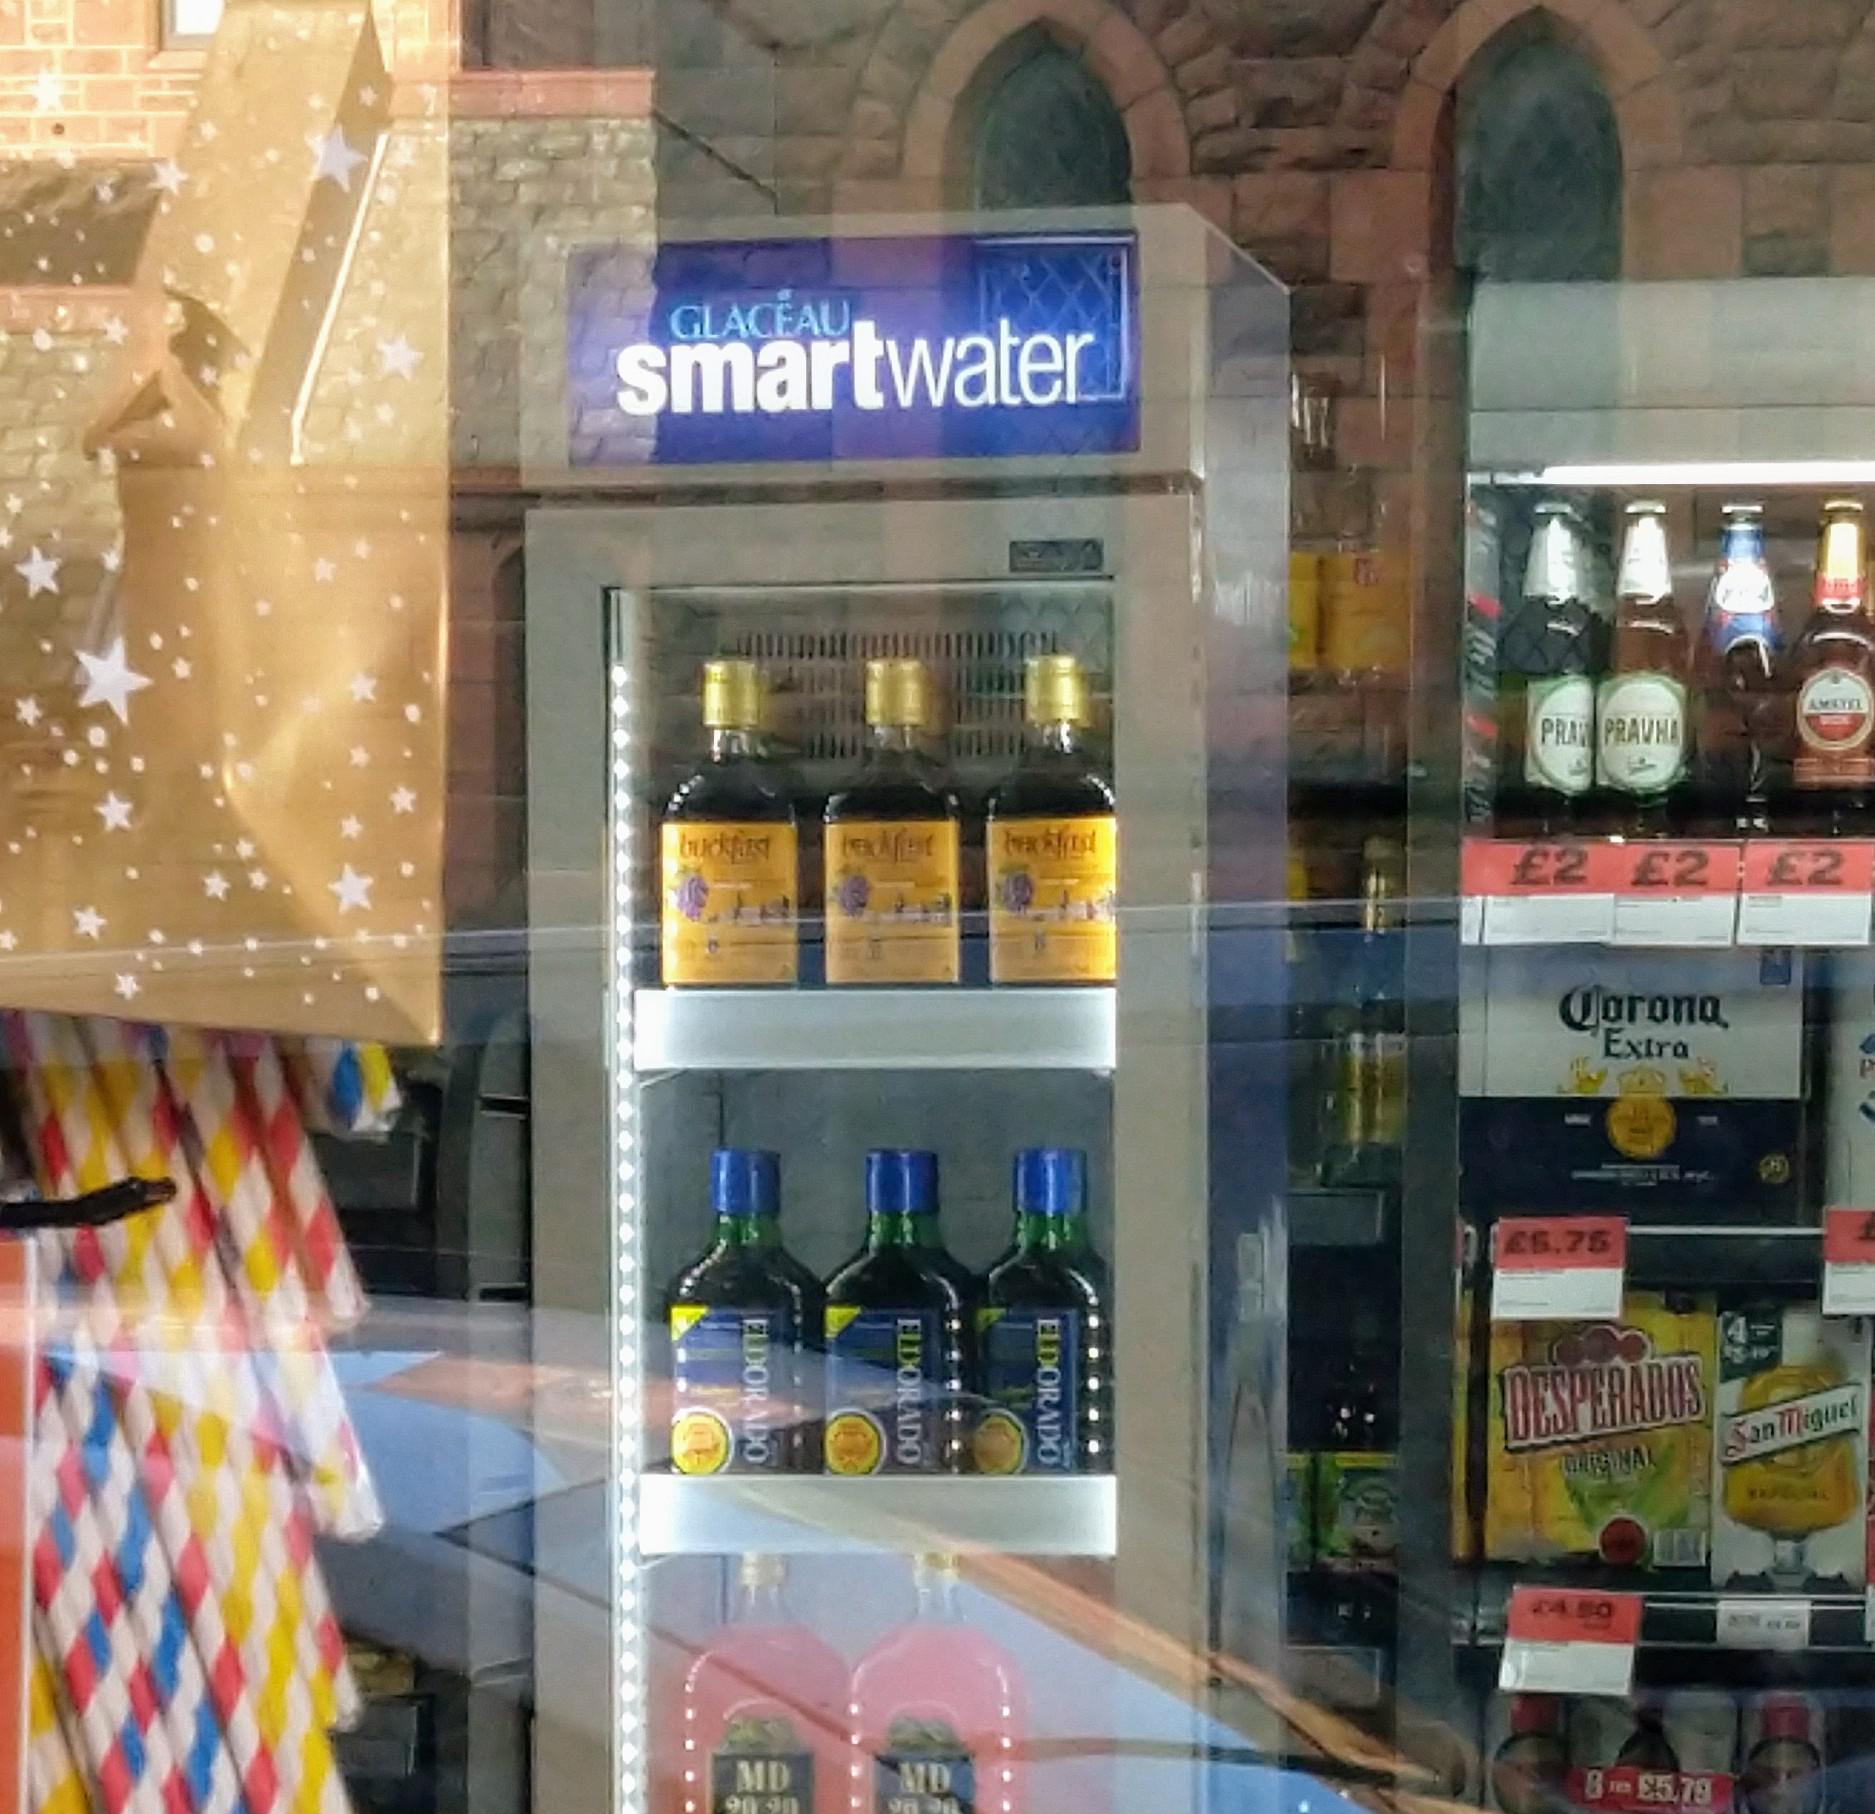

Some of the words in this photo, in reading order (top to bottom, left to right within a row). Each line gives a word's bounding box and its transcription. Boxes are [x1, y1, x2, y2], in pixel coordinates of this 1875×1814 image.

[614, 317, 1095, 417] smartwater
[1604, 717, 1679, 745] PRAVHA
[1510, 847, 1589, 886] £2
[1631, 849, 1709, 887] £2
[1767, 849, 1844, 886] £2
[1559, 984, 1729, 1037] Corona
[1603, 1028, 1690, 1060] Extra
[1509, 1359, 1703, 1442] DESPERADOS
[1725, 1416, 1775, 1458] San
[1776, 1394, 1858, 1436] Miguel
[736, 1760, 791, 1793] MD
[902, 1761, 951, 1794] MD
